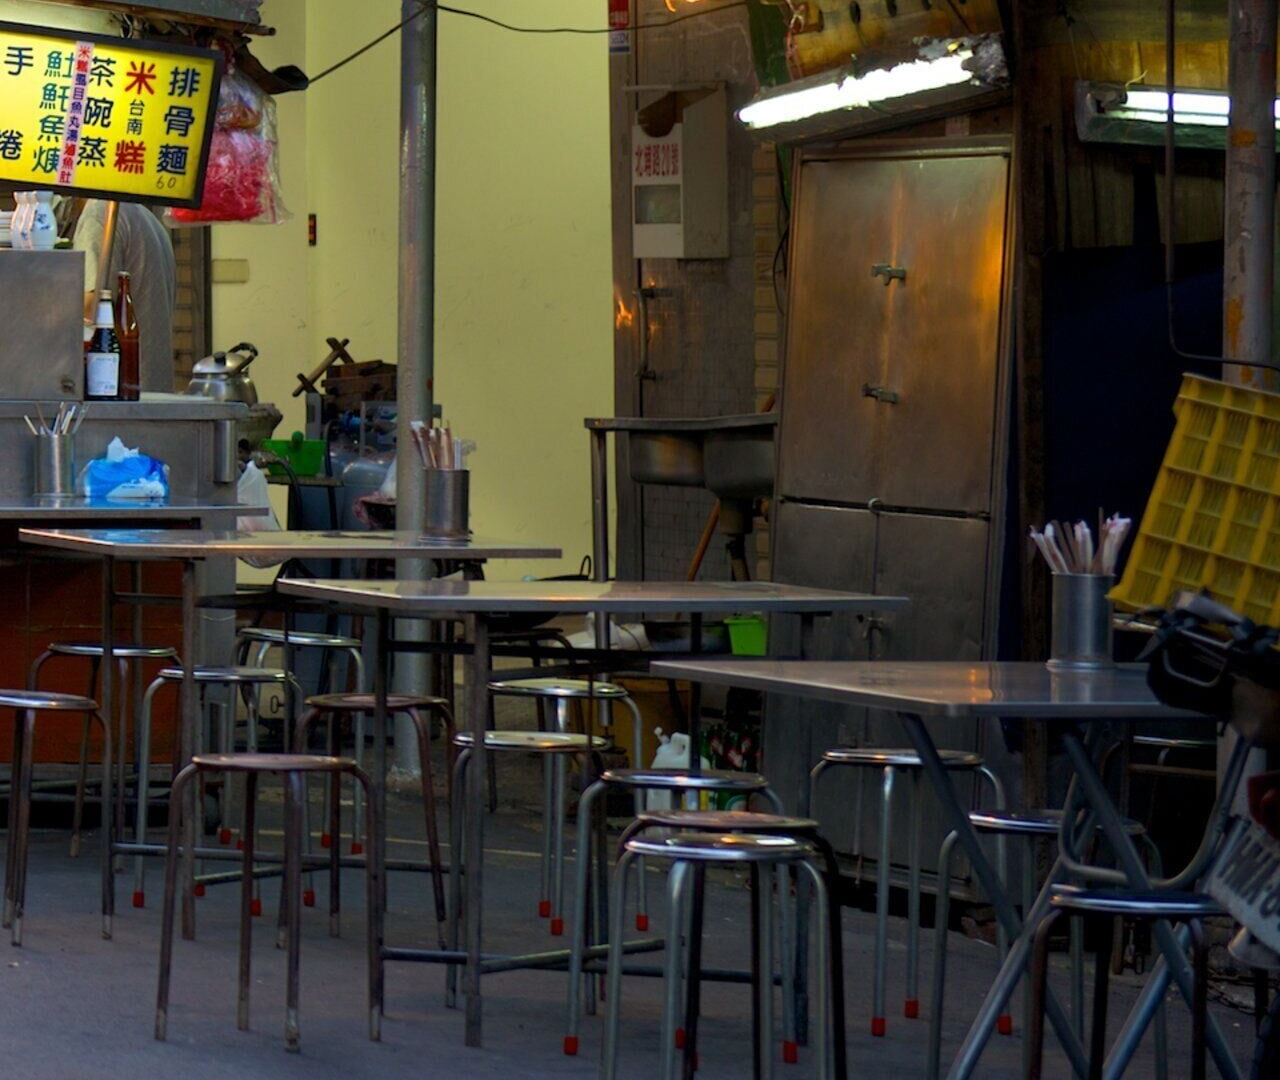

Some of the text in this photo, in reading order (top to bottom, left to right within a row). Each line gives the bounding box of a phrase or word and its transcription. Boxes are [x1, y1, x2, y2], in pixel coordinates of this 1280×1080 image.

[76, 55, 117, 168] 茶碗蒸
[156, 66, 201, 175] 排骨麵
